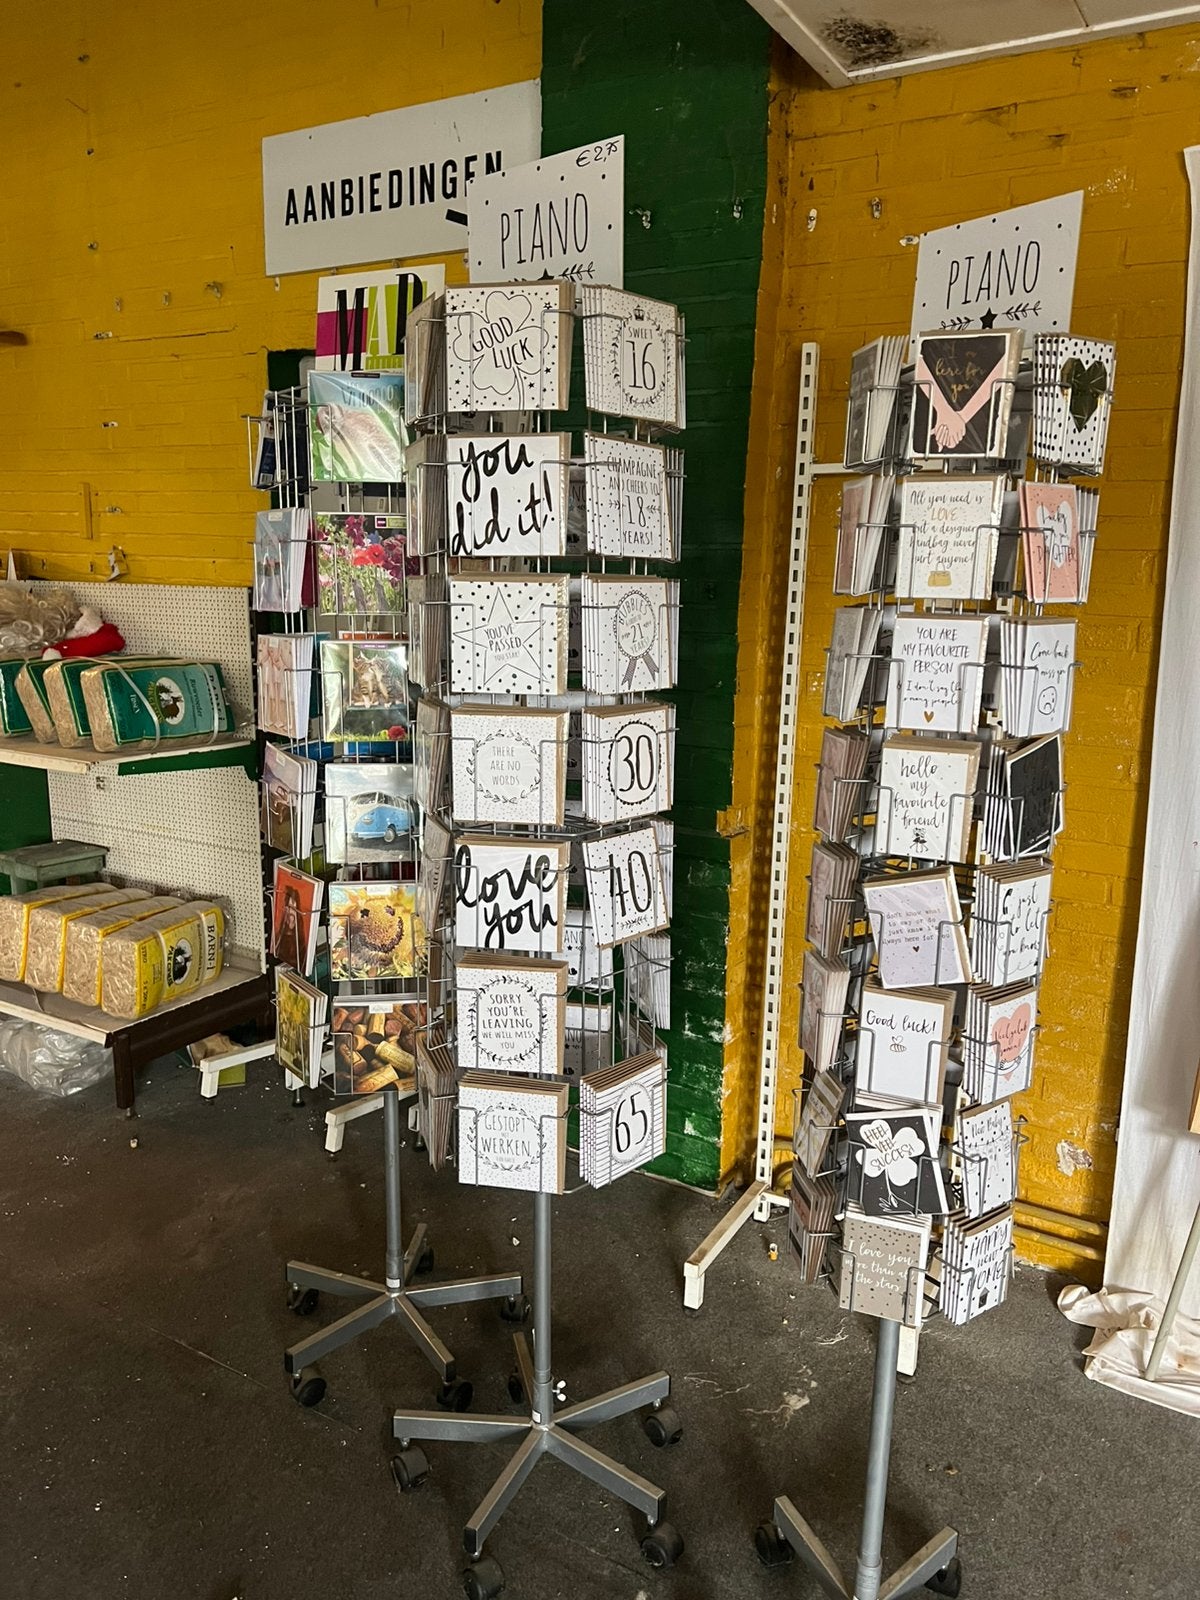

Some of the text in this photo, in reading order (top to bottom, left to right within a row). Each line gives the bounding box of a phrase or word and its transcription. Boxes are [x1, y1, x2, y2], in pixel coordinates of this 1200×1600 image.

[500, 193, 588, 269] PIANO
[946, 241, 1041, 310] PIANO
[472, 316, 513, 353] GOOD
[628, 326, 654, 340] SWEET
[493, 337, 534, 370] LUCK
[625, 340, 656, 391] 16
[459, 438, 534, 503] you
[606, 455, 658, 480] CHAMPAGNE
[609, 475, 624, 491] AND
[626, 478, 649, 496] CHEERS
[949, 491, 972, 504] need
[451, 469, 555, 556] did it!
[624, 494, 647, 528] 18
[930, 507, 959, 521] LOVE
[622, 530, 653, 545] YEARS!
[484, 623, 514, 640] YOU'VE
[630, 622, 644, 643] 21
[917, 626, 959, 642] YOU ARE
[488, 636, 523, 653] PASSED
[902, 642, 970, 659] MY FAVOURITE
[913, 660, 954, 675] PERSON
[492, 745, 515, 758] THERE
[490, 760, 521, 772] ARE NO
[618, 734, 655, 792] 30
[901, 755, 938, 778] hello
[492, 775, 521, 786] WORDS
[910, 780, 929, 797] my
[894, 791, 949, 812] favourite
[902, 810, 945, 830] friend!
[455, 844, 559, 909] love
[483, 899, 558, 949] you
[490, 993, 522, 1005] SORRY
[487, 1005, 524, 1017] YOU'RE
[482, 1018, 533, 1029] LEAVING
[866, 1009, 937, 1035] Good luck!
[482, 1030, 536, 1039] WE WILL MISS
[500, 1041, 515, 1049] YOU
[484, 1113, 526, 1133] GESTOPT
[615, 1090, 649, 1154] 65
[863, 1124, 890, 1144] HEEL
[480, 1136, 531, 1157] WERKEN
[874, 1136, 898, 1154] VEEL
[869, 1142, 916, 1172] SUCCES!
[970, 1224, 1008, 1261] HAPPY
[847, 1239, 915, 1267] I love you
[844, 1257, 868, 1270] mre
[870, 1259, 894, 1277] than
[854, 1270, 901, 1292] the stars
